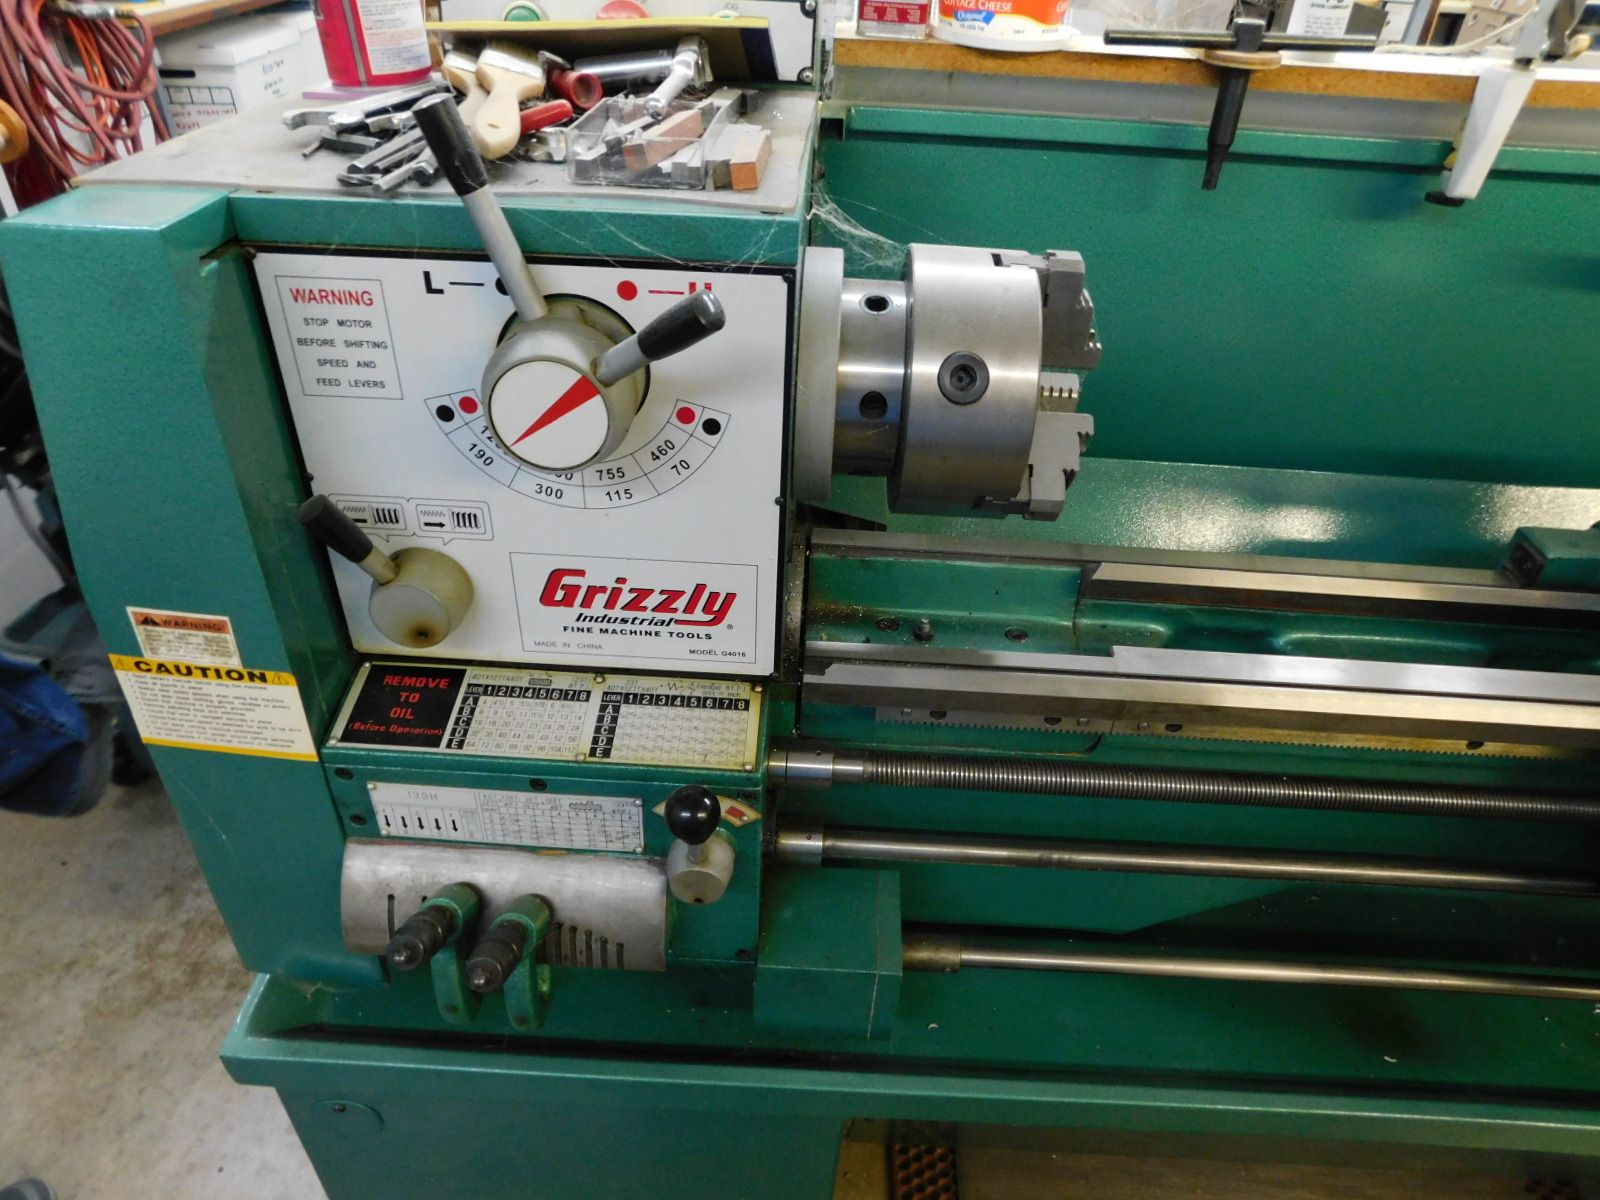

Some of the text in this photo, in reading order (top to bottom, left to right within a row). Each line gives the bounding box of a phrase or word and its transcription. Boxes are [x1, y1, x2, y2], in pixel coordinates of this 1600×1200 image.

[978, 1, 1012, 11] CHEESE
[423, 271, 444, 294] L
[290, 288, 373, 306] WARNING
[303, 317, 372, 328] STOP MOTOR
[297, 338, 388, 350] BEFORE SHIFTING
[317, 358, 376, 369] SPEED AND
[316, 378, 385, 389] FEED LEVERS
[467, 442, 495, 467] 190
[650, 439, 676, 463] 460
[670, 458, 691, 476] 70
[595, 467, 625, 481] 755
[534, 483, 563, 500] 300
[604, 488, 633, 502] 115
[539, 568, 737, 627] Grizzly
[575, 612, 675, 628] Industrial
[563, 625, 712, 640] FINE MACHINE TOOLS
[534, 640, 557, 648] MADE
[576, 642, 603, 650] CHINA
[689, 649, 746, 658] MODEL G4016
[134, 660, 267, 684] CAUTION
[384, 675, 450, 689] REMOVE
[400, 692, 421, 704] TO
[498, 687, 505, 696] 2
[512, 687, 519, 696] 3
[525, 688, 533, 697] 4
[540, 690, 547, 698] 5
[552, 690, 559, 699] 6
[567, 690, 574, 699] 7
[579, 691, 587, 700] 8
[464, 697, 474, 706] A
[603, 694, 621, 702] LEVER
[643, 695, 649, 704] 2
[658, 696, 666, 705] 3
[674, 697, 681, 706] 4
[690, 698, 697, 707] 5
[706, 698, 713, 707] 6
[723, 699, 729, 708] 7
[738, 700, 744, 709] 8
[389, 707, 415, 720] OIL
[462, 707, 470, 716] B
[605, 705, 613, 714] A
[459, 718, 466, 726] C
[603, 715, 611, 724] B
[455, 729, 463, 737] D
[600, 726, 609, 735] C
[451, 740, 459, 749] E
[598, 737, 607, 745] D
[595, 747, 604, 756] E
